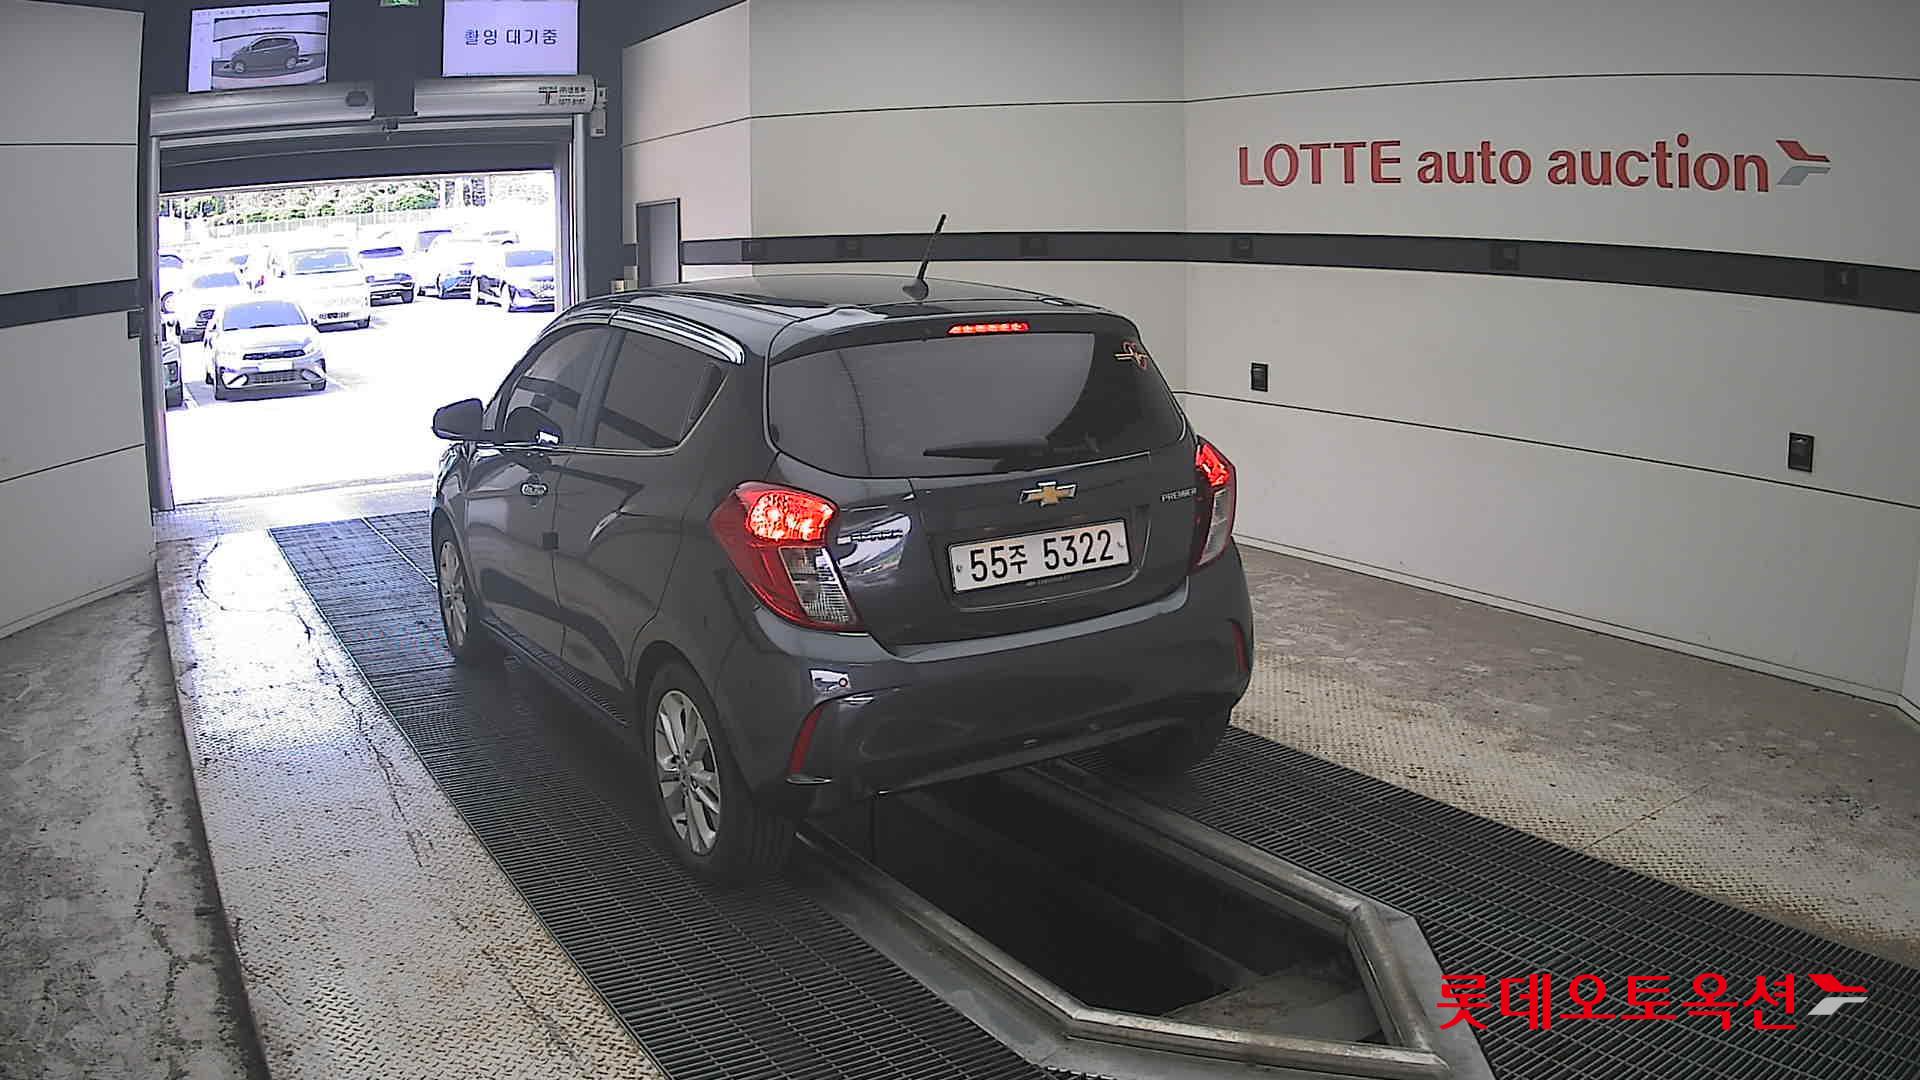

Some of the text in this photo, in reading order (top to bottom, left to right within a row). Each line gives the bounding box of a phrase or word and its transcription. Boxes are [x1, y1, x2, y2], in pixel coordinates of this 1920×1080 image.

[464, 29, 558, 46] 촬영 대기중
[1238, 133, 1769, 193] LOTTE auto auction
[969, 529, 1114, 583] 55주 5322
